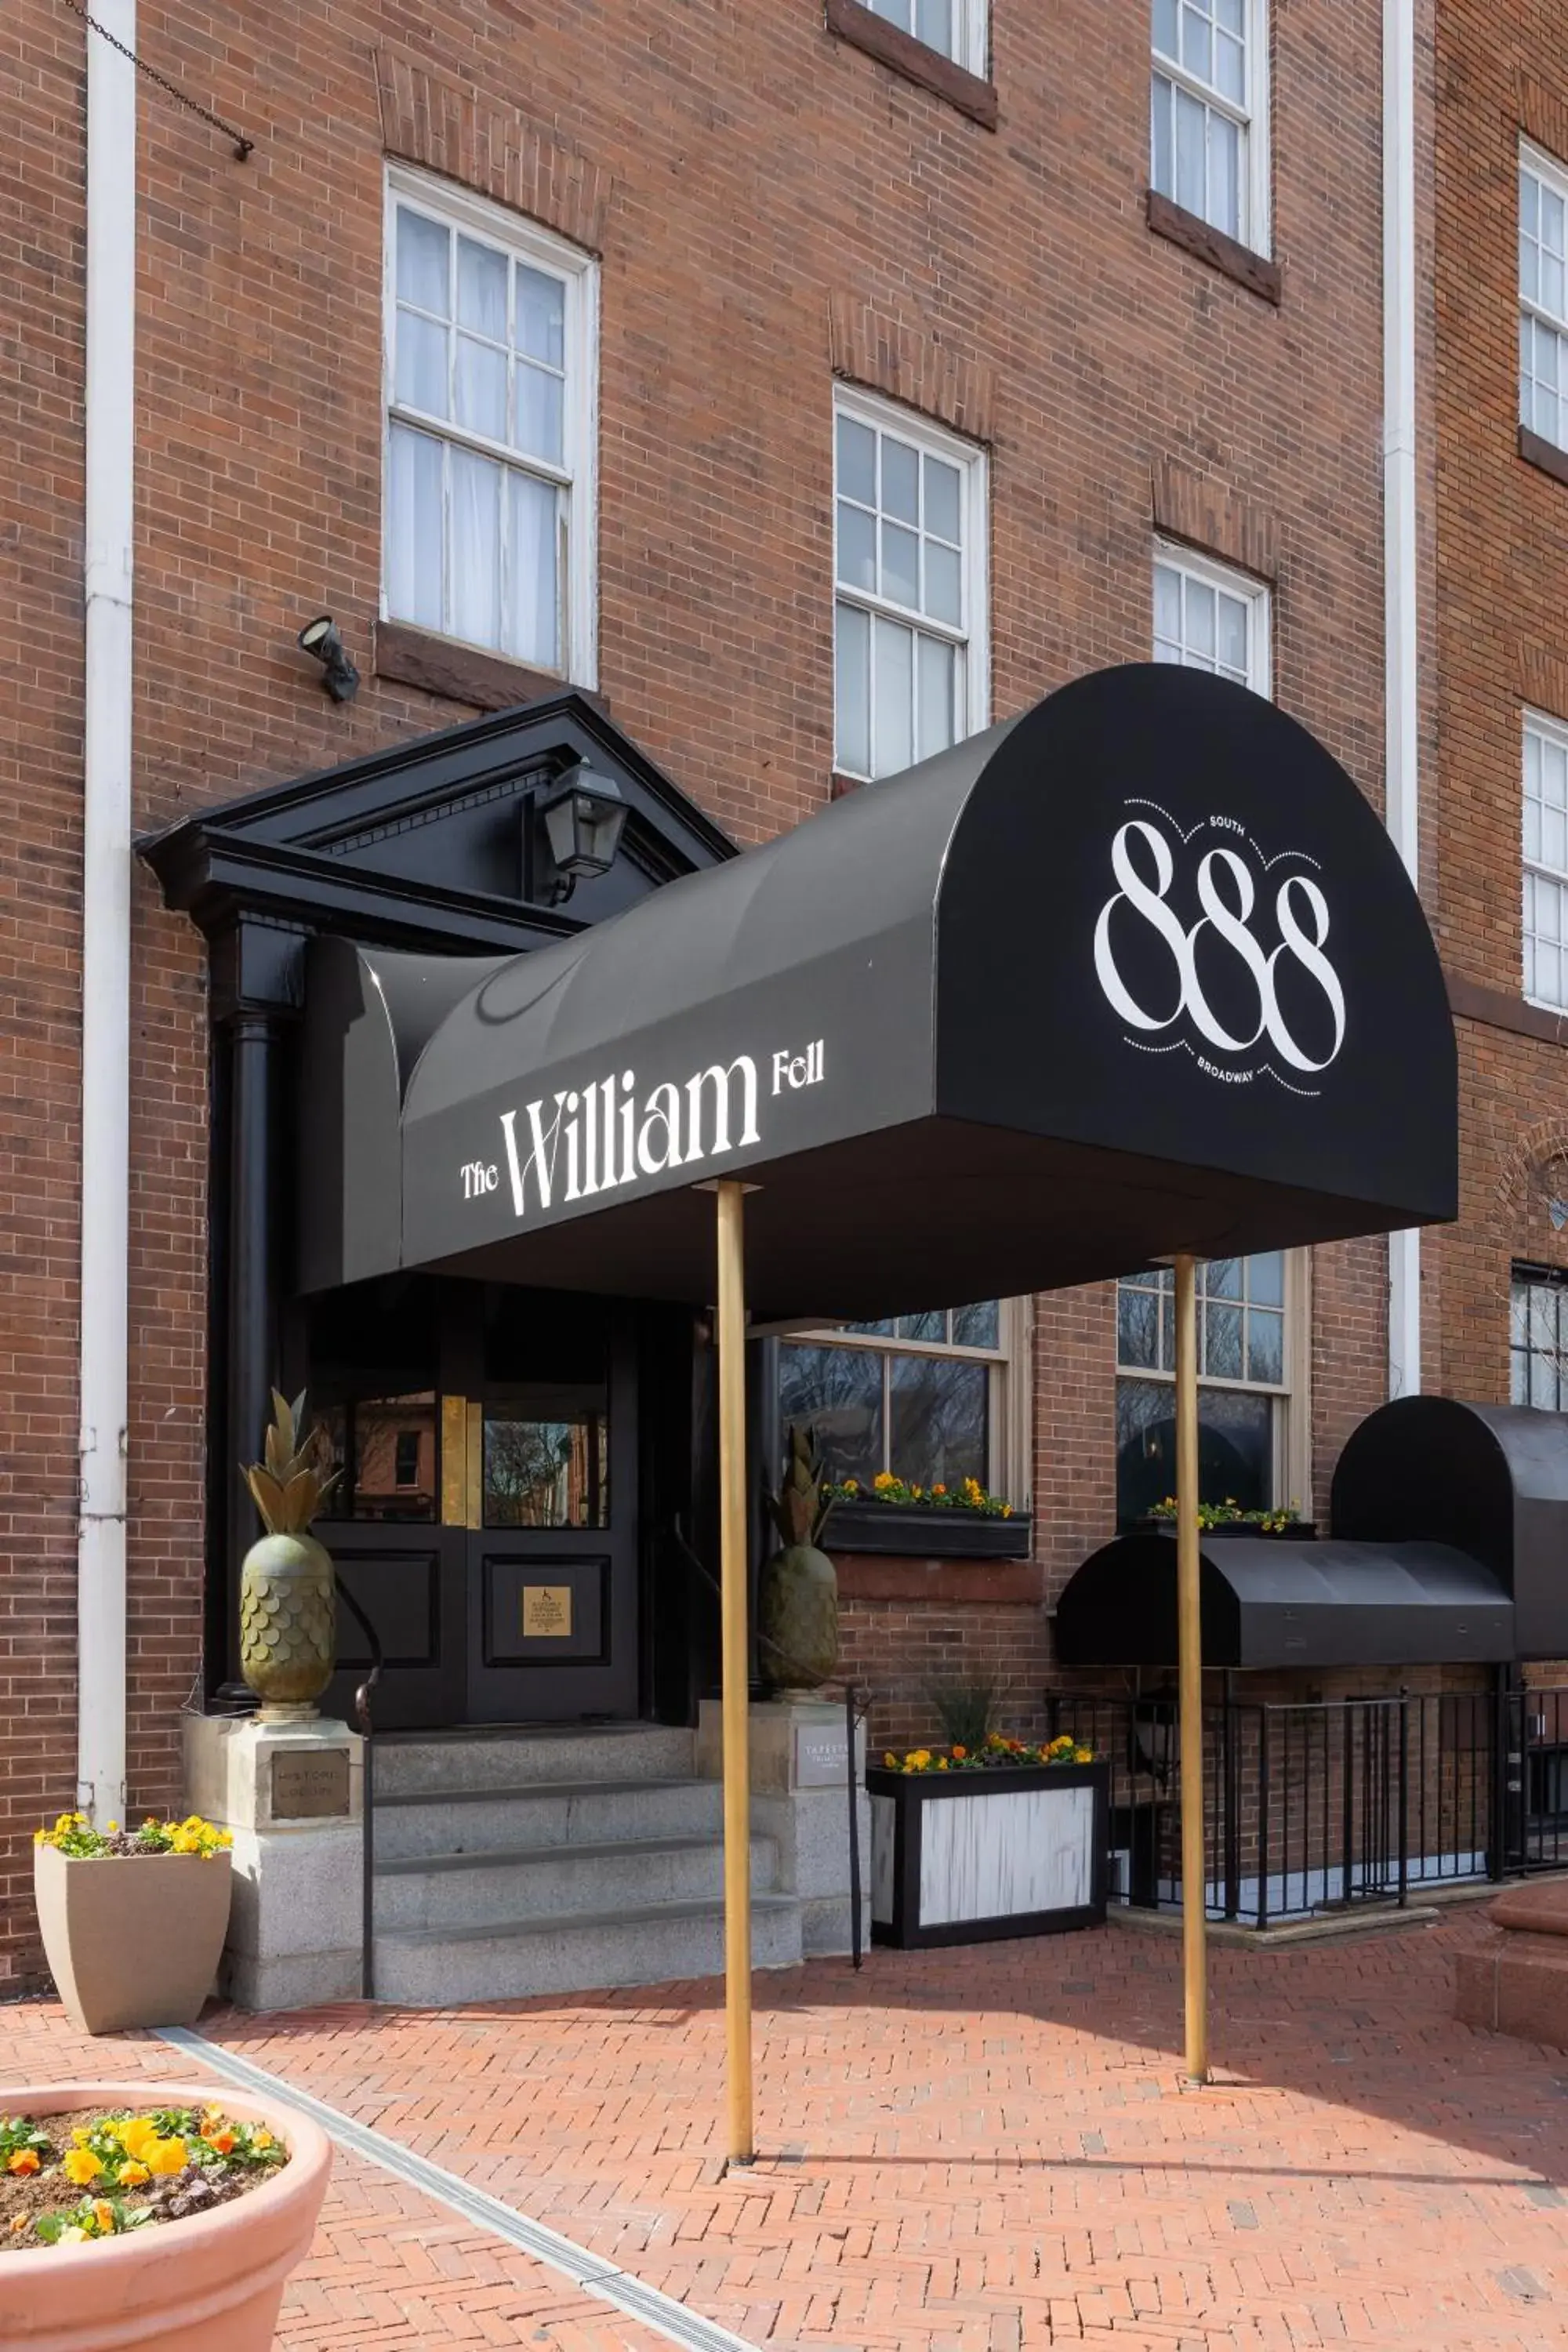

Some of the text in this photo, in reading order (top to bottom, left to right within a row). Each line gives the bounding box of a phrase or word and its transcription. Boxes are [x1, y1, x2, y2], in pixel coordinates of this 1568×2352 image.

[1210, 815, 1246, 837] SOUTH
[1094, 820, 1346, 1072] 888
[1197, 1056, 1254, 1083] BROADWAY
[460, 1039, 824, 1217] The William Fell
